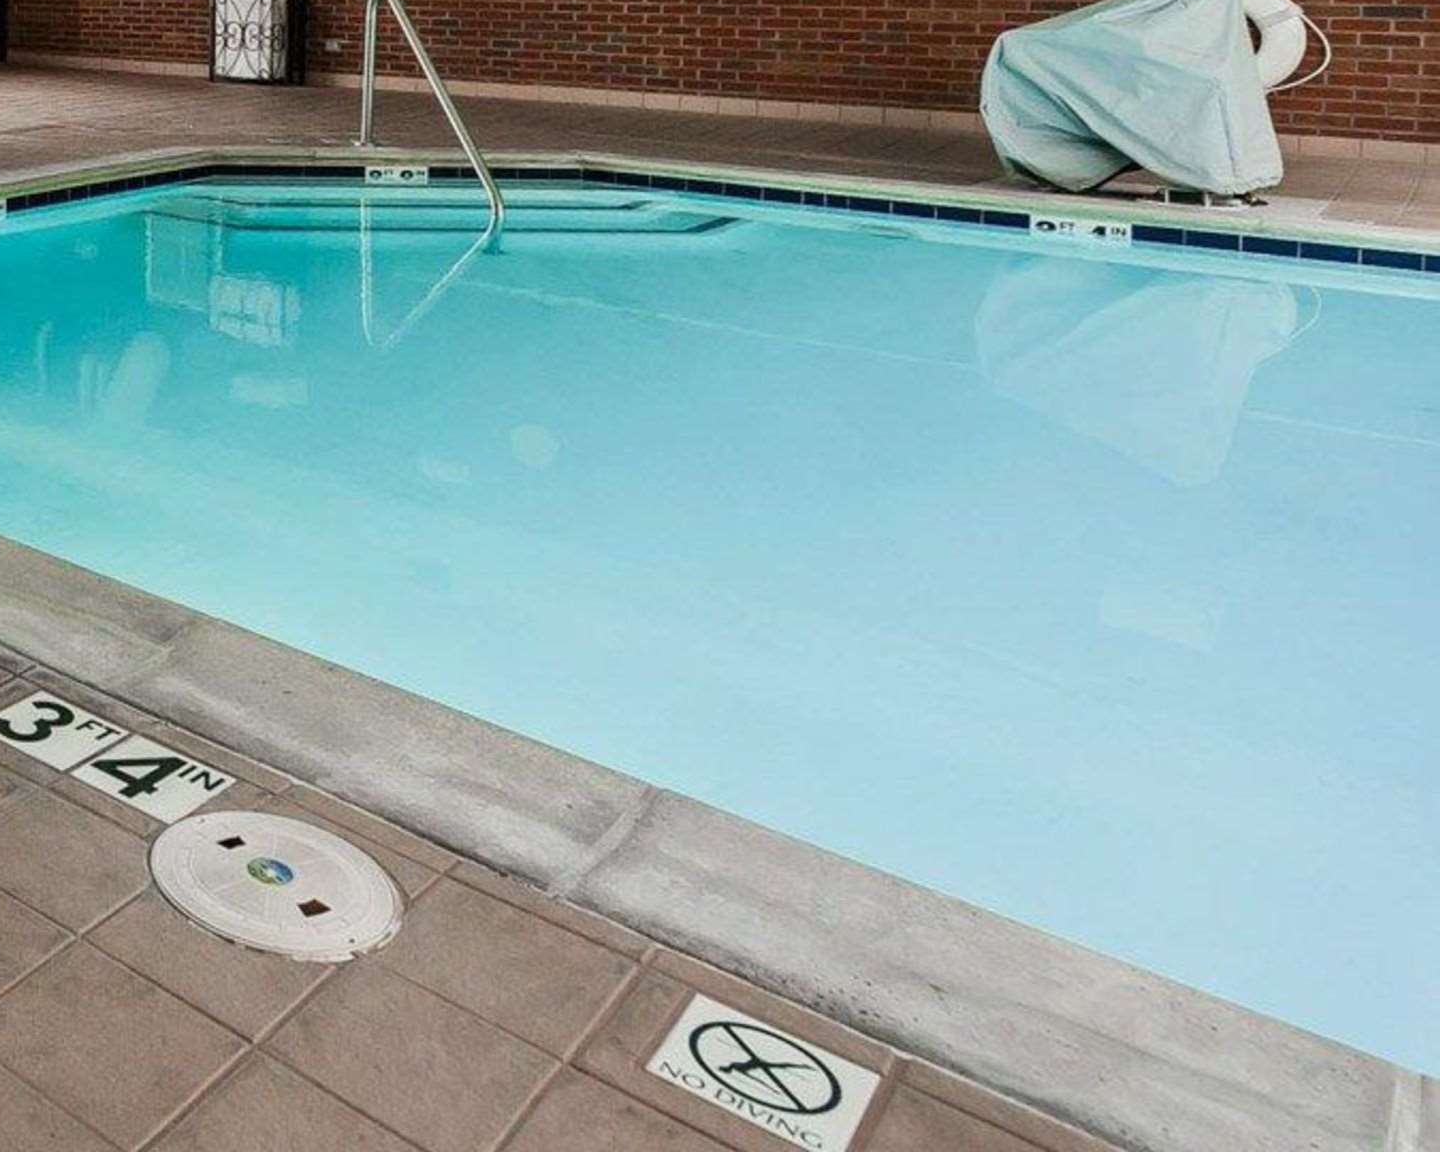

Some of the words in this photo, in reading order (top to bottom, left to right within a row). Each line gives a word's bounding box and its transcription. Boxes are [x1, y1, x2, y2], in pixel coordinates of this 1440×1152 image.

[76, 719, 121, 741] FT
[91, 756, 188, 799] 4
[177, 765, 225, 792] IN
[659, 1059, 706, 1090] NO
[713, 1089, 824, 1150] DIVING
